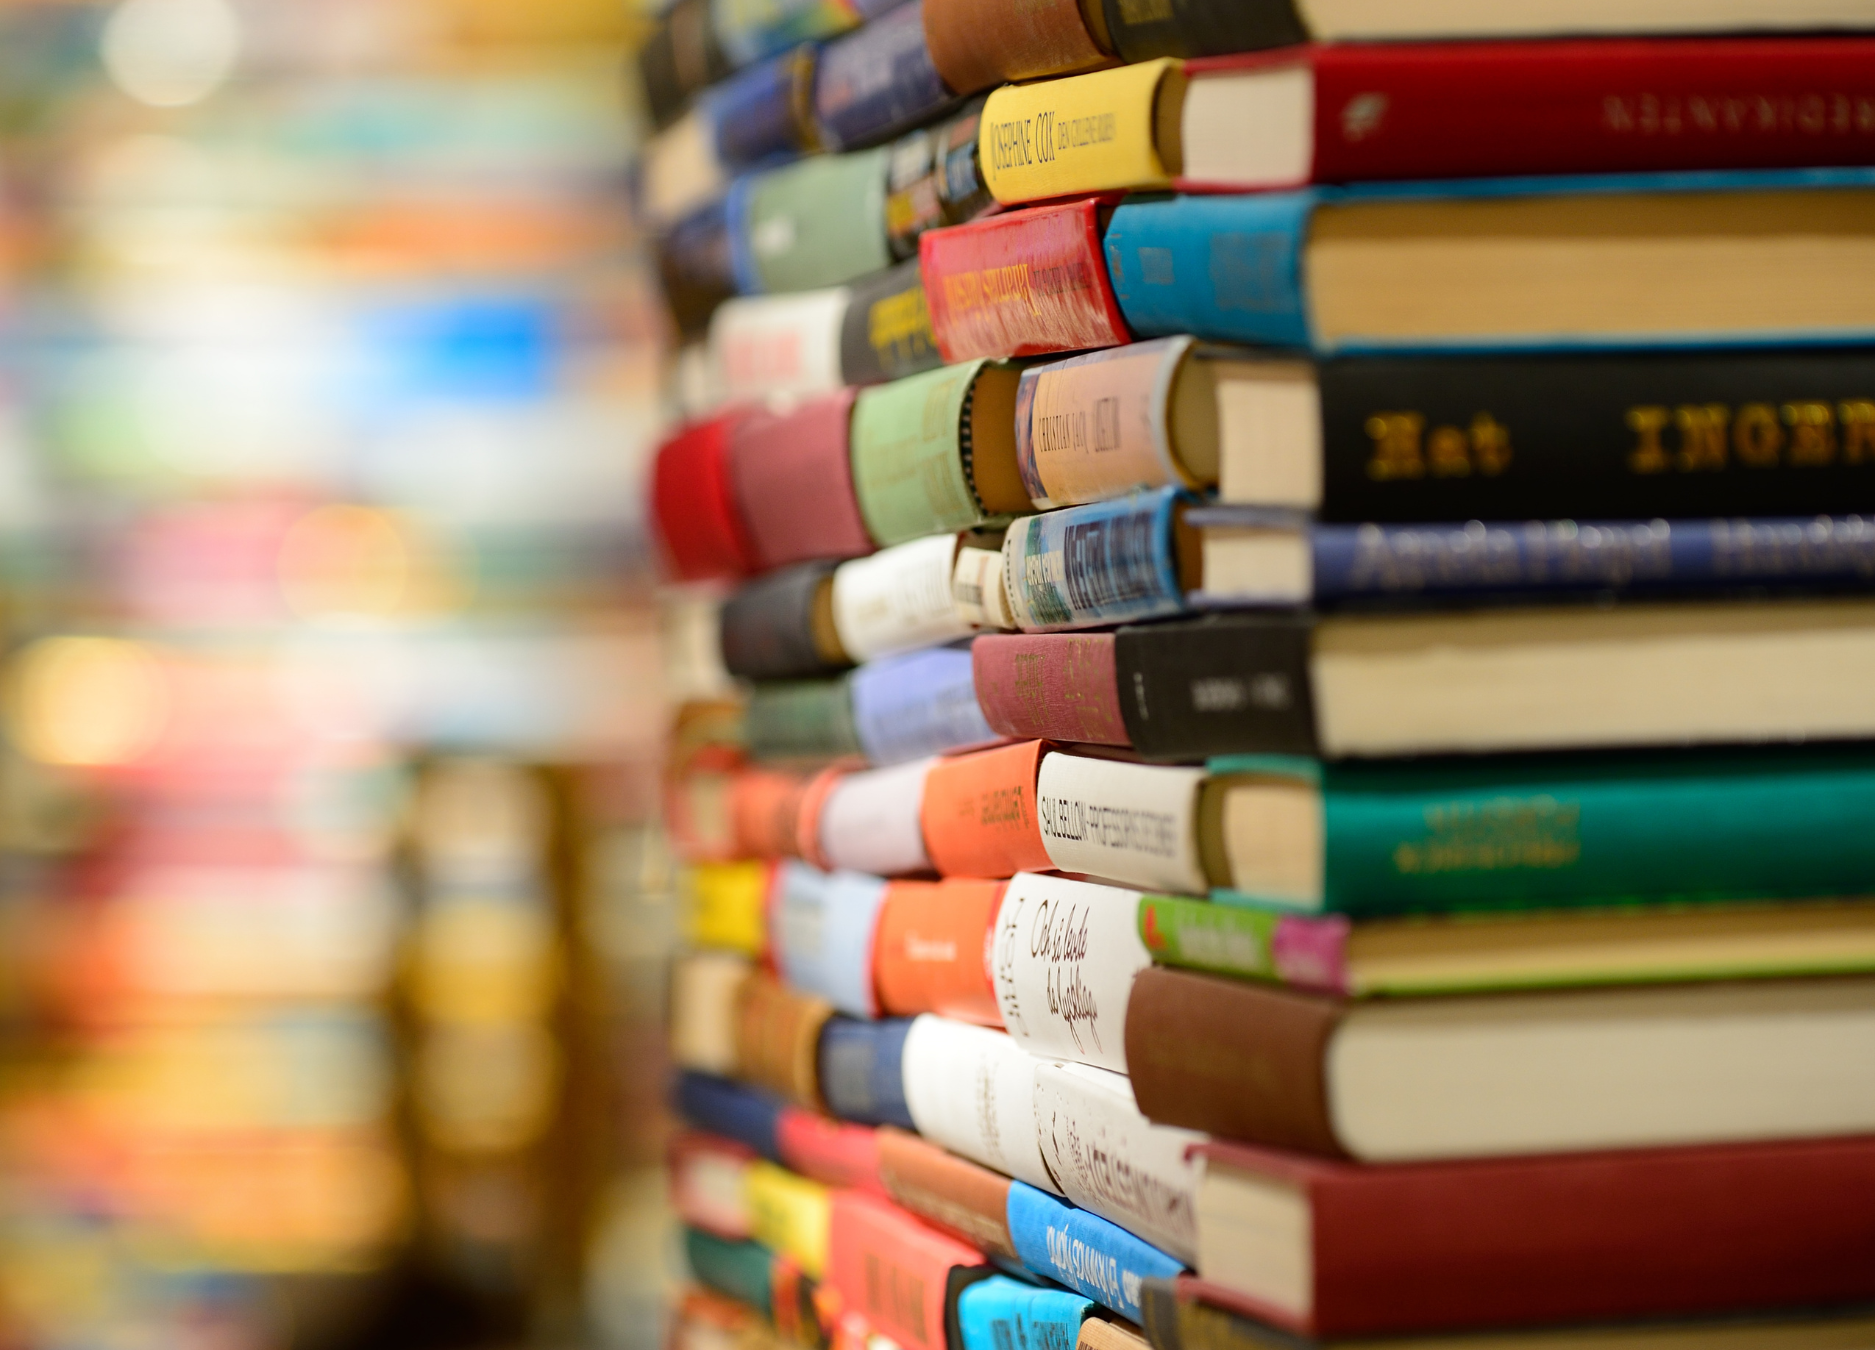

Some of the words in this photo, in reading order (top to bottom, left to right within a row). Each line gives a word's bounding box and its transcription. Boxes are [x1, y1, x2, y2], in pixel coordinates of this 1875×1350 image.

[990, 118, 1032, 181] JOSEPHINE
[1035, 110, 1055, 164] COX
[1038, 413, 1070, 453] CHRISTIAN
[1042, 796, 1058, 838] SAUL
[1031, 899, 1059, 963] Och
[1064, 903, 1090, 963] levde
